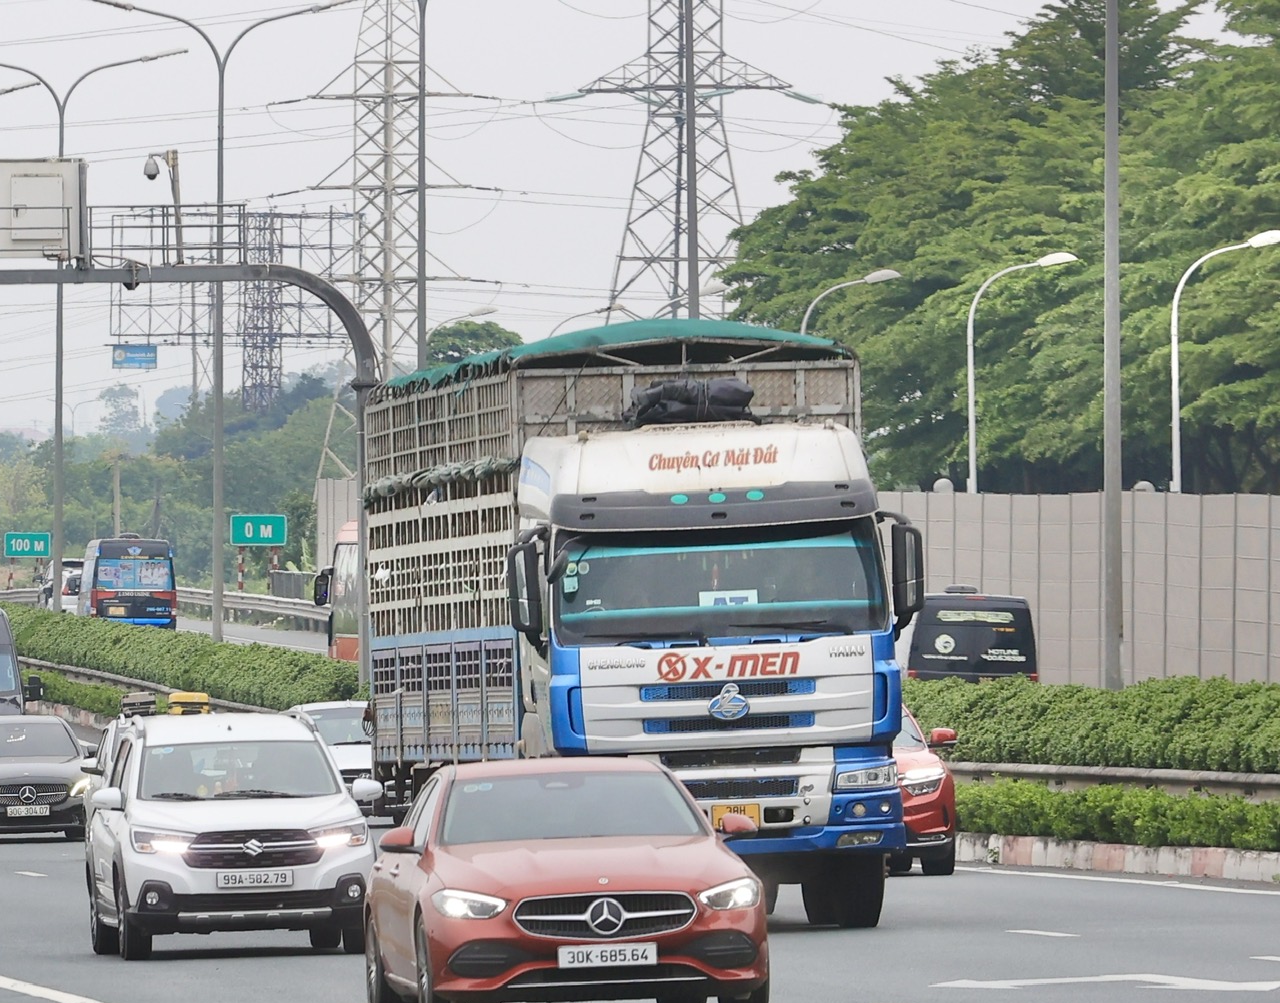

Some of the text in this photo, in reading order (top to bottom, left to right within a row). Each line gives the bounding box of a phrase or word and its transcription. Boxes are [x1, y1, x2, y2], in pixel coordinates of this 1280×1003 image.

[649, 451, 699, 473] Chuyên
[724, 448, 750, 471] Mặt
[244, 522, 273, 538] 0 M
[10, 538, 44, 551] 100 M
[588, 657, 646, 671] CHENGLONG
[223, 872, 287, 885] 99A-582.79
[567, 948, 649, 964] 30K-685.64
